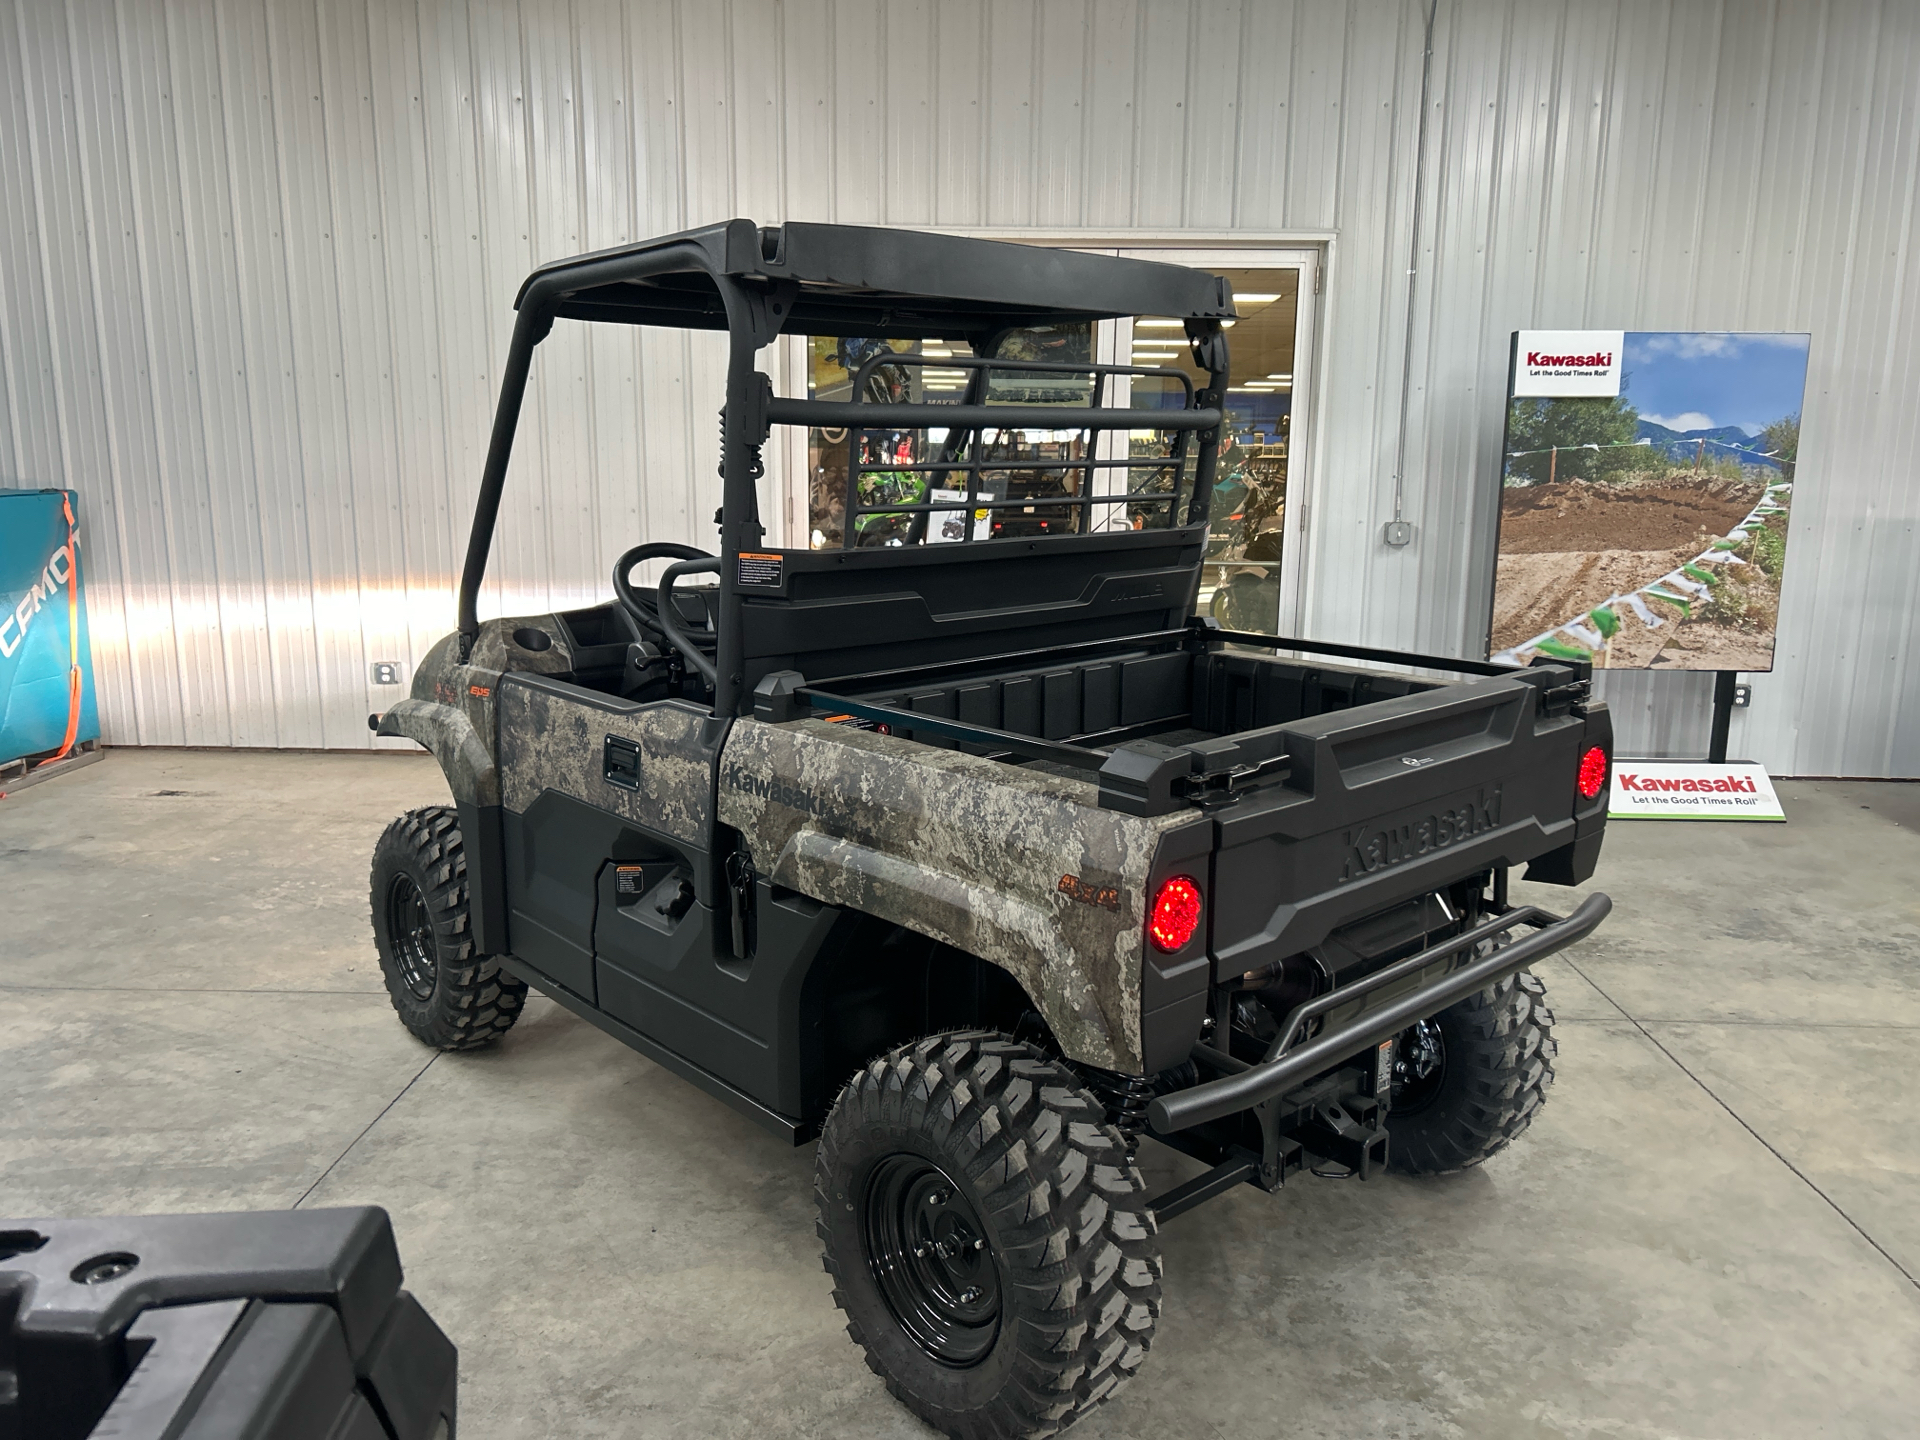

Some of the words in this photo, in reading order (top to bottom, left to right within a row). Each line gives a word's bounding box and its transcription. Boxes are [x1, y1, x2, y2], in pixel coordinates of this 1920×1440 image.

[1527, 351, 1612, 367] Kawasaki
[1529, 369, 1541, 377] Let
[1542, 369, 1553, 377] the
[1554, 369, 1572, 377] Good
[1573, 369, 1593, 377] Times
[729, 761, 828, 815] Kawasaki
[1618, 774, 1757, 793] Kawasaki
[1632, 795, 1650, 804] Let
[1651, 796, 1669, 805] the
[1670, 796, 1699, 805] Good
[1701, 797, 1733, 806] Times
[1338, 782, 1503, 883] Kawasaki
